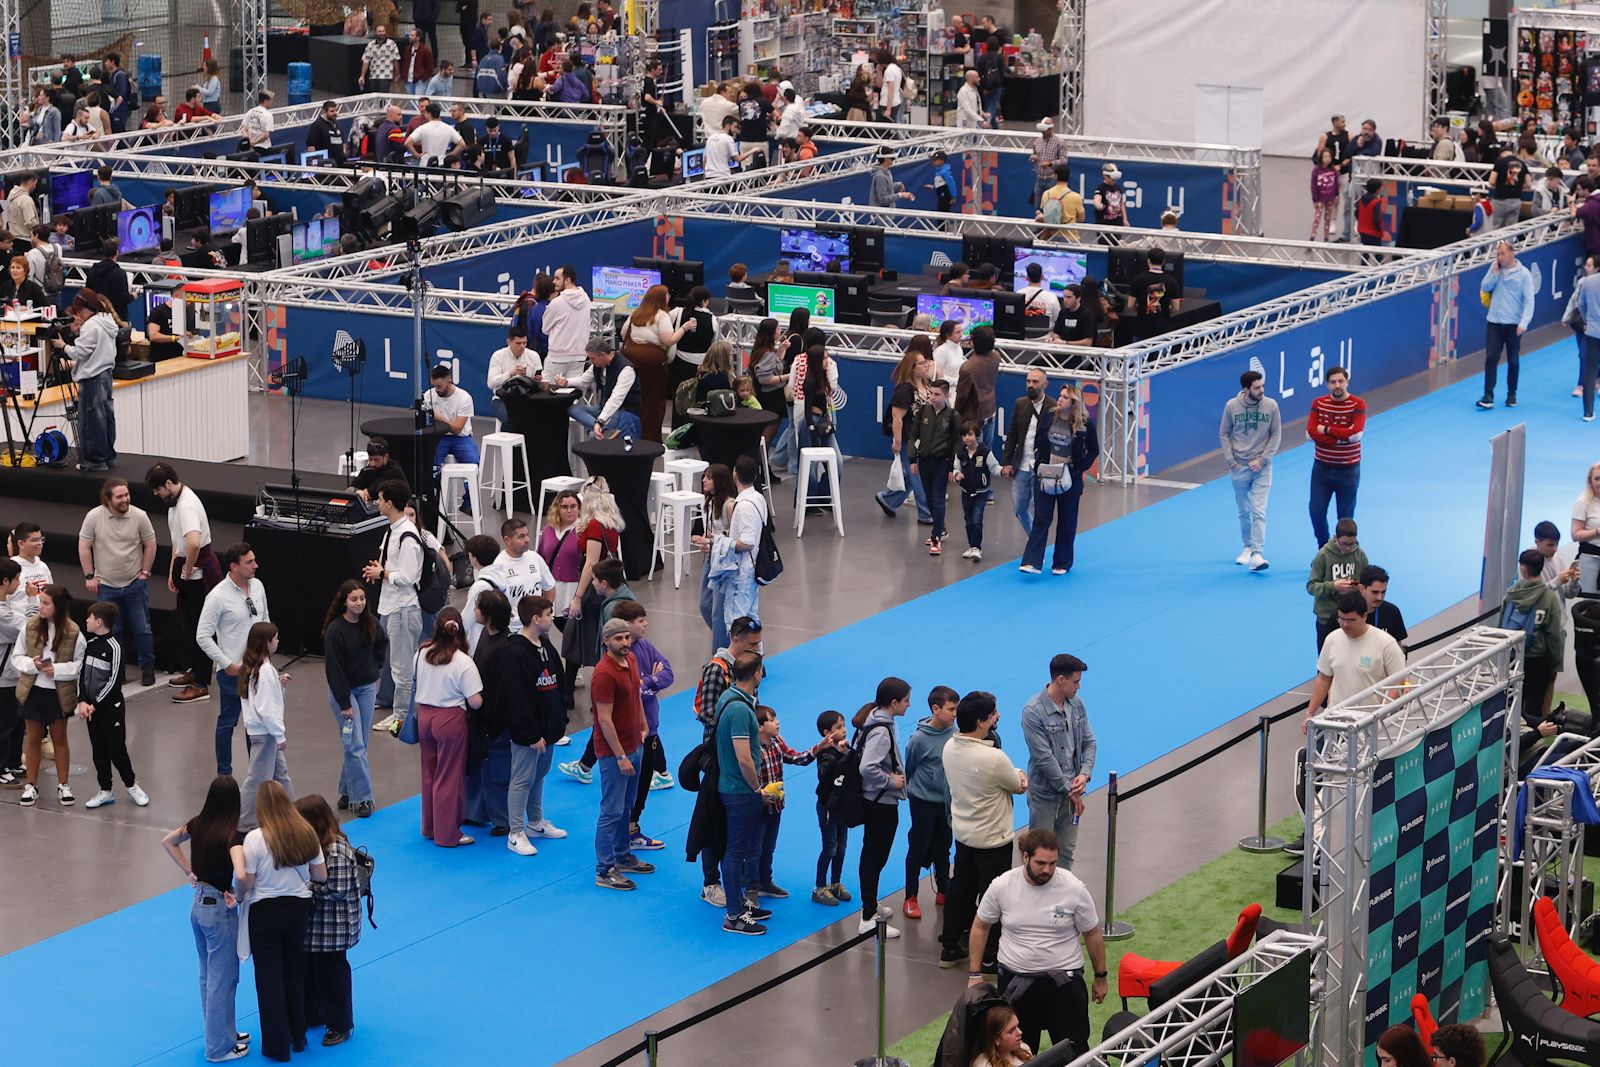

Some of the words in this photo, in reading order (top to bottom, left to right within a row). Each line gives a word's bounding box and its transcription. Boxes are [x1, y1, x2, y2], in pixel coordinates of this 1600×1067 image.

[623, 280, 642, 288] MAKER
[642, 278, 649, 288] 2
[1332, 563, 1356, 580] PLAY
